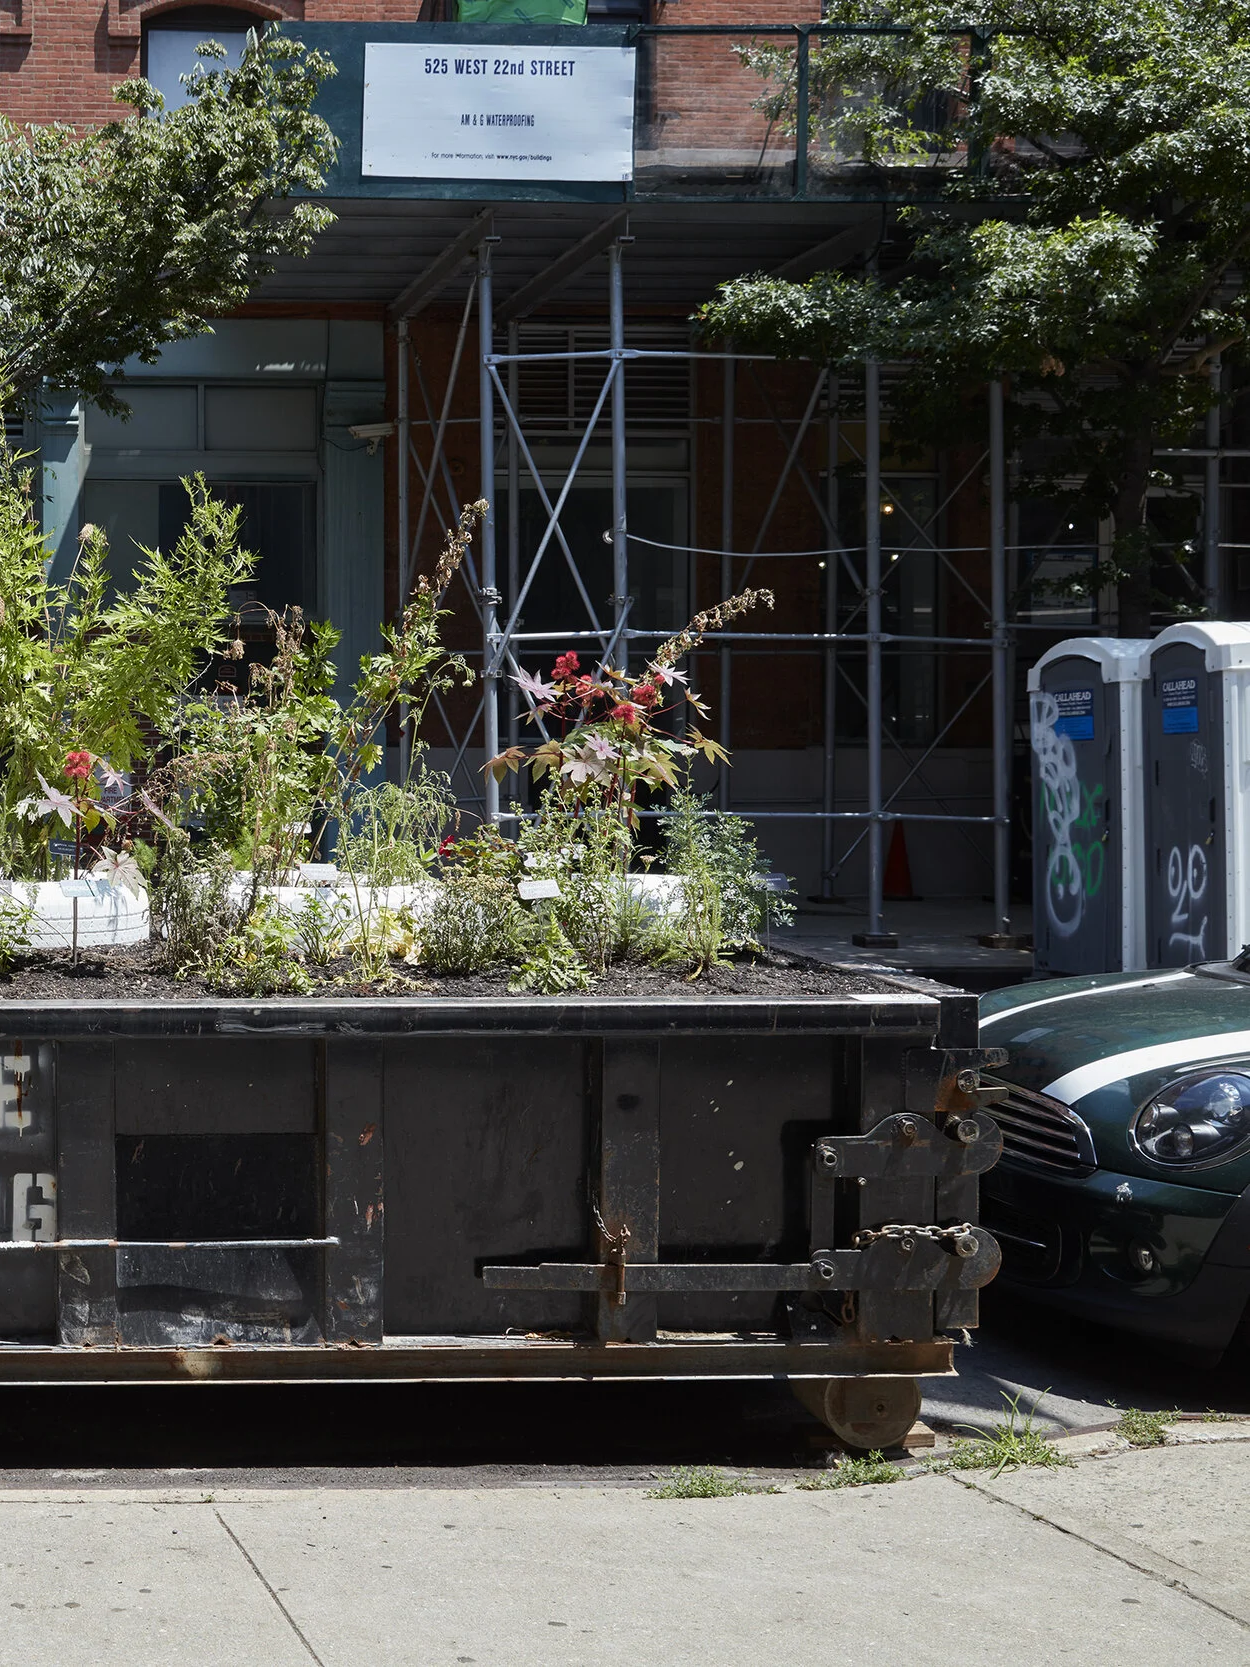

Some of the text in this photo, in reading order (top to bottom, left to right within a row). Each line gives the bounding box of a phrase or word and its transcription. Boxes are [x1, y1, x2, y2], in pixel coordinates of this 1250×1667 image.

[424, 58, 576, 76] 525 WEST 22nd STREET
[460, 113, 535, 127] AM & G WATERPROOFING
[496, 154, 552, 162] www.nyc.gov/buildings
[1162, 680, 1196, 692] CALLAHEAD
[1054, 691, 1092, 702] CALLAHEAD
[104, 786, 118, 795] FIRE
